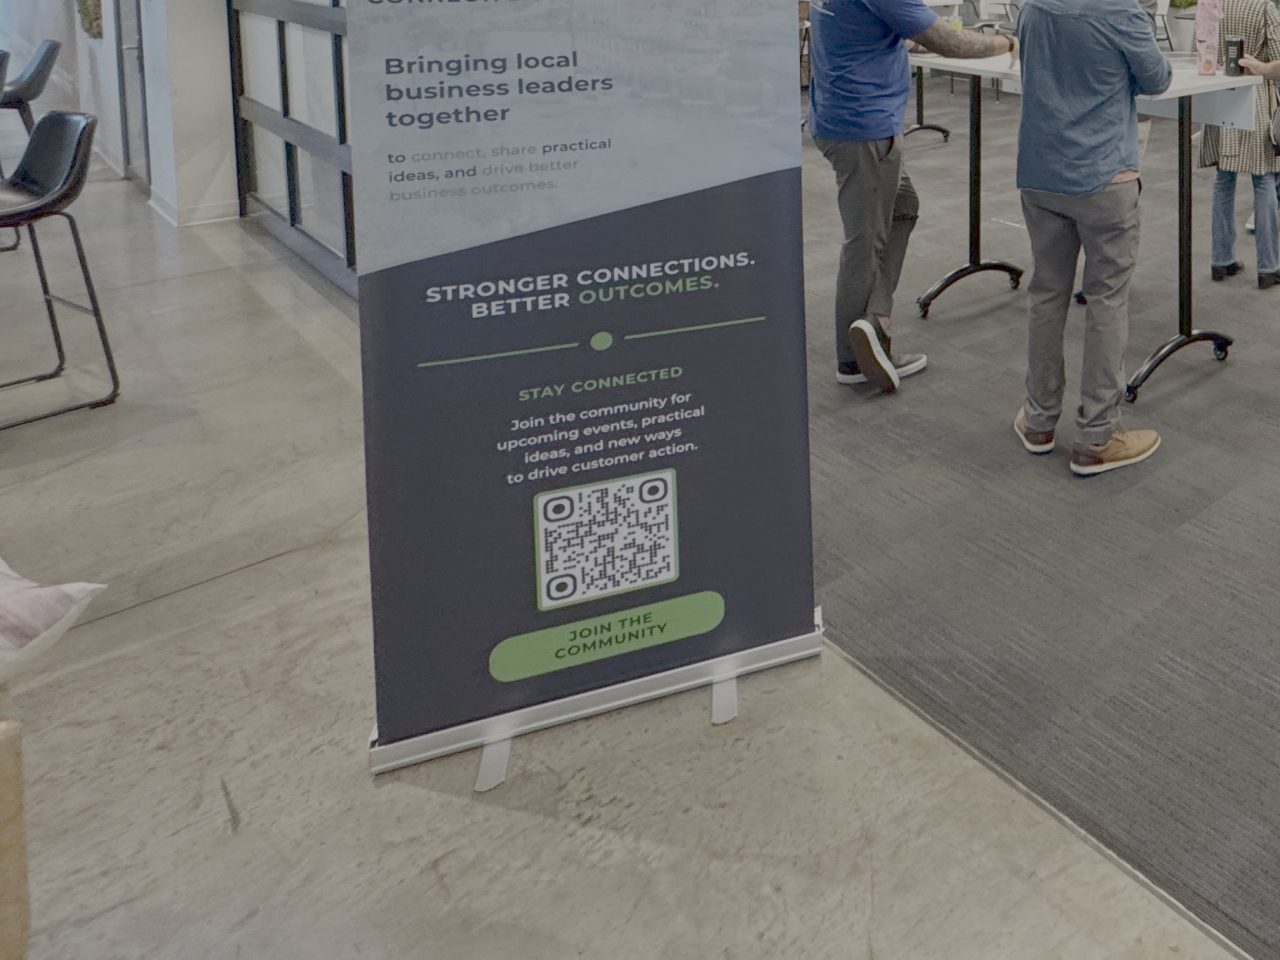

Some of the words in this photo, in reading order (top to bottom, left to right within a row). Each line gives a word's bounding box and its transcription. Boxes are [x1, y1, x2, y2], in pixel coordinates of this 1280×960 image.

[385, 54, 507, 76] Bringing
[517, 51, 578, 70] local
[386, 81, 509, 101] business
[518, 75, 613, 96] leaders
[385, 105, 510, 129] together
[387, 152, 406, 164] to
[411, 146, 487, 163] connect,
[491, 143, 537, 156] share
[542, 138, 612, 155] practical
[388, 168, 439, 183] ideas,
[444, 165, 477, 178] and
[482, 161, 524, 176] drive
[528, 158, 579, 172] better
[389, 186, 466, 202] business
[471, 181, 558, 195] outcomes.
[426, 273, 568, 303] STRONGER
[576, 252, 755, 286] CONNECTIONS.
[472, 292, 570, 318] BETTER
[578, 276, 719, 305] OUTCOMES.
[519, 384, 565, 401] STAY
[572, 366, 683, 393] CONNECTED
[497, 428, 579, 451] upcoming
[583, 418, 638, 436] events,
[642, 406, 705, 429] practical
[511, 417, 544, 430] Join
[549, 411, 576, 423] the
[580, 399, 667, 421] community
[671, 392, 692, 406] for
[507, 472, 524, 484] to
[528, 465, 567, 480] drive
[572, 452, 644, 472] customer
[649, 440, 698, 458] action.
[525, 445, 571, 464] ideas,
[575, 439, 604, 453] and
[608, 435, 641, 447] new
[645, 427, 682, 444] ways
[554, 622, 667, 659] COMMUNITY
[569, 621, 612, 641] JOIN
[618, 612, 653, 629] THE
